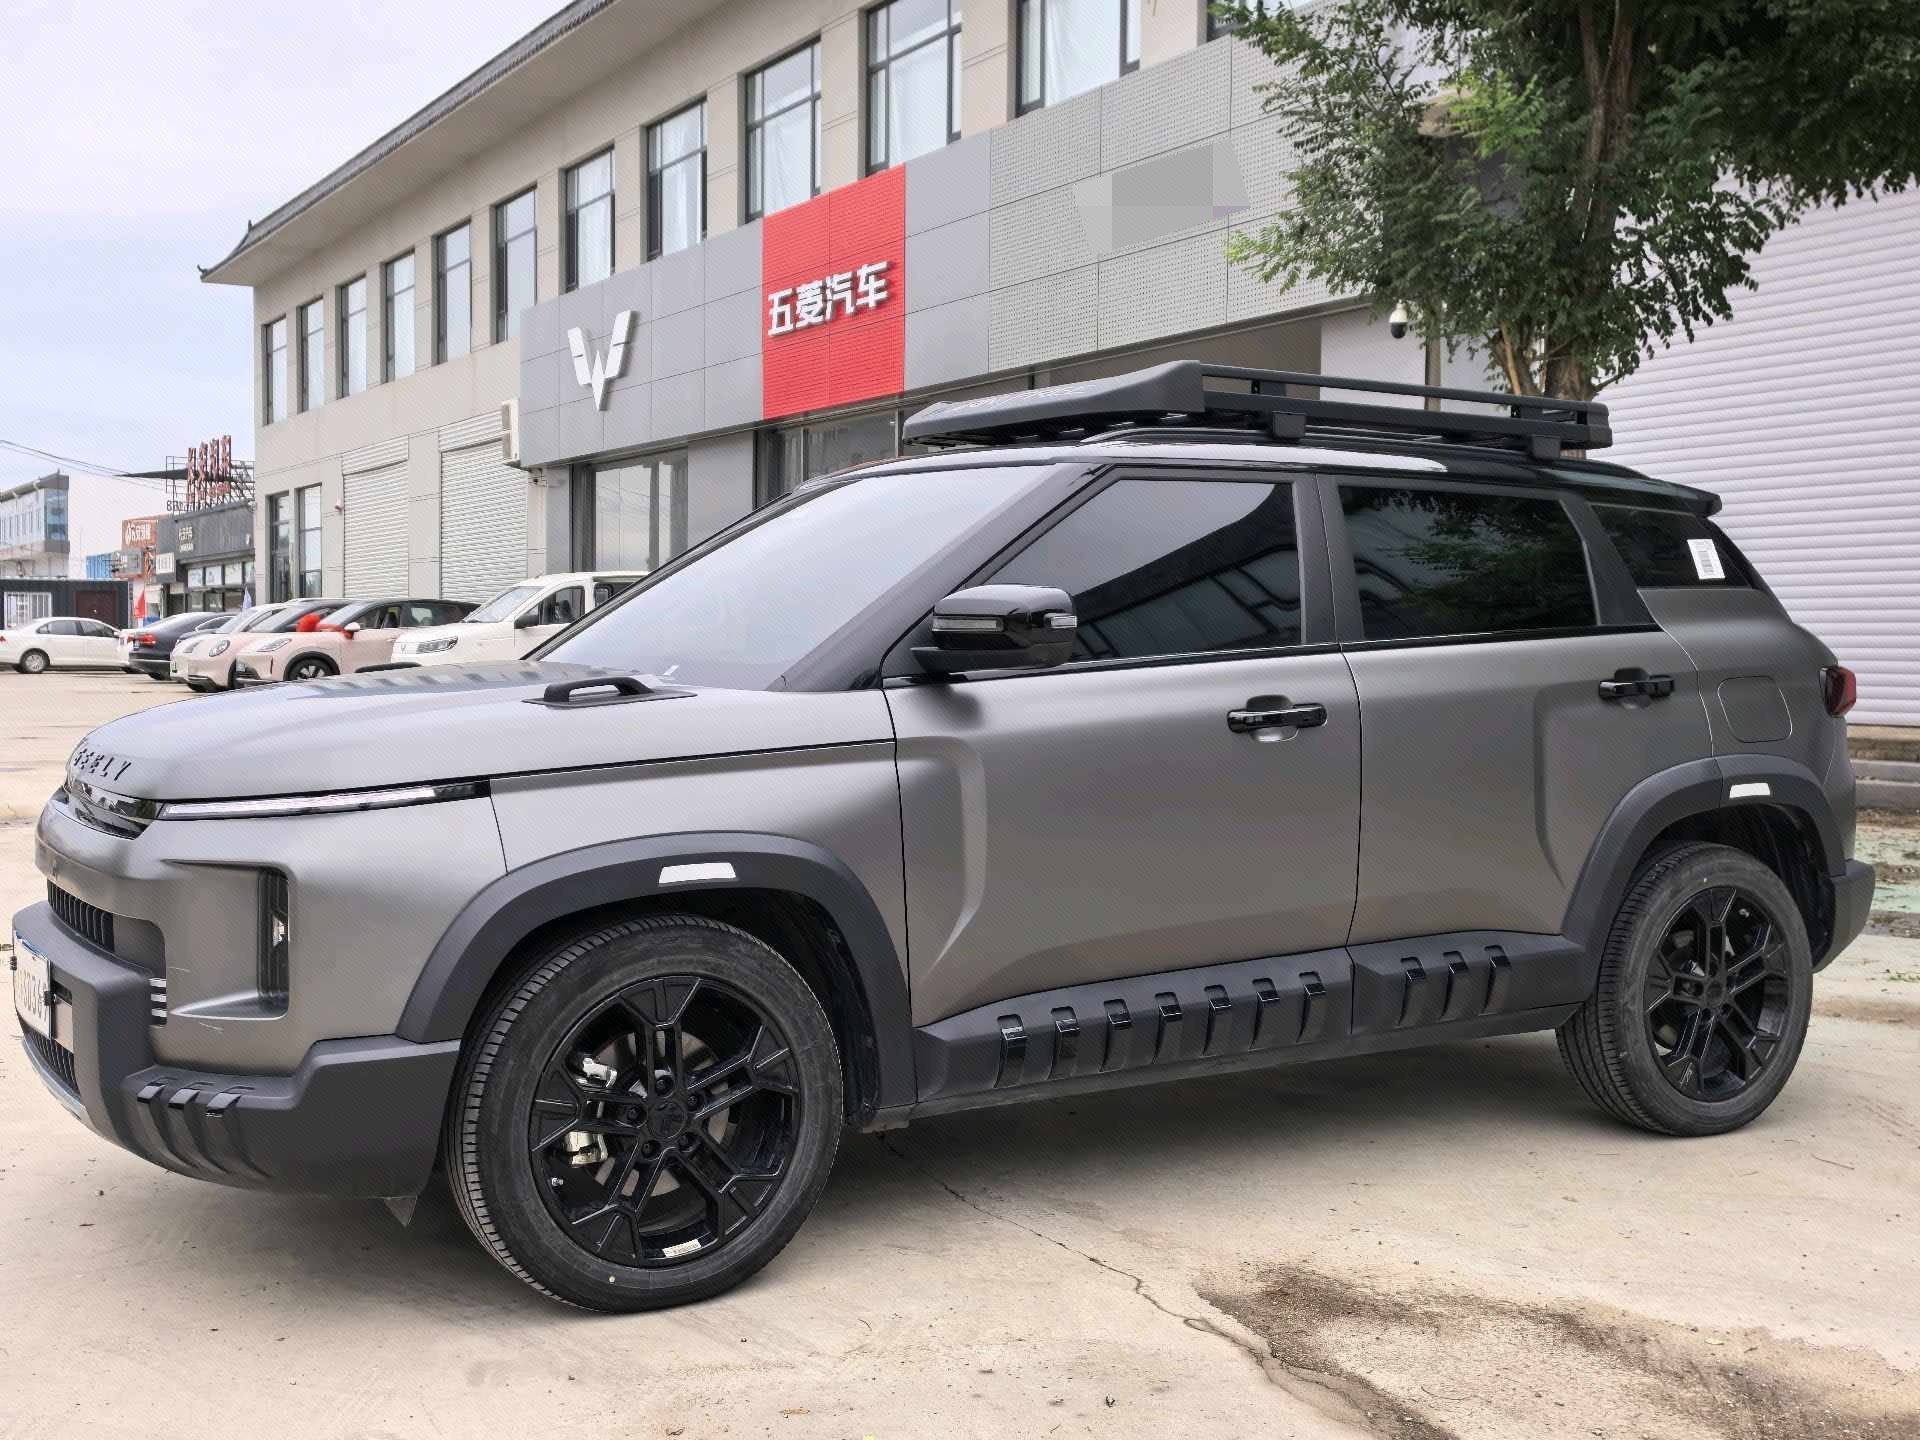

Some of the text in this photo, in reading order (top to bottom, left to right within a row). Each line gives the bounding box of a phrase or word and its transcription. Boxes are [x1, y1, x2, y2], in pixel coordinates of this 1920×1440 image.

[767, 260, 889, 336] 五菱汽车
[73, 747, 131, 781] GEELY
